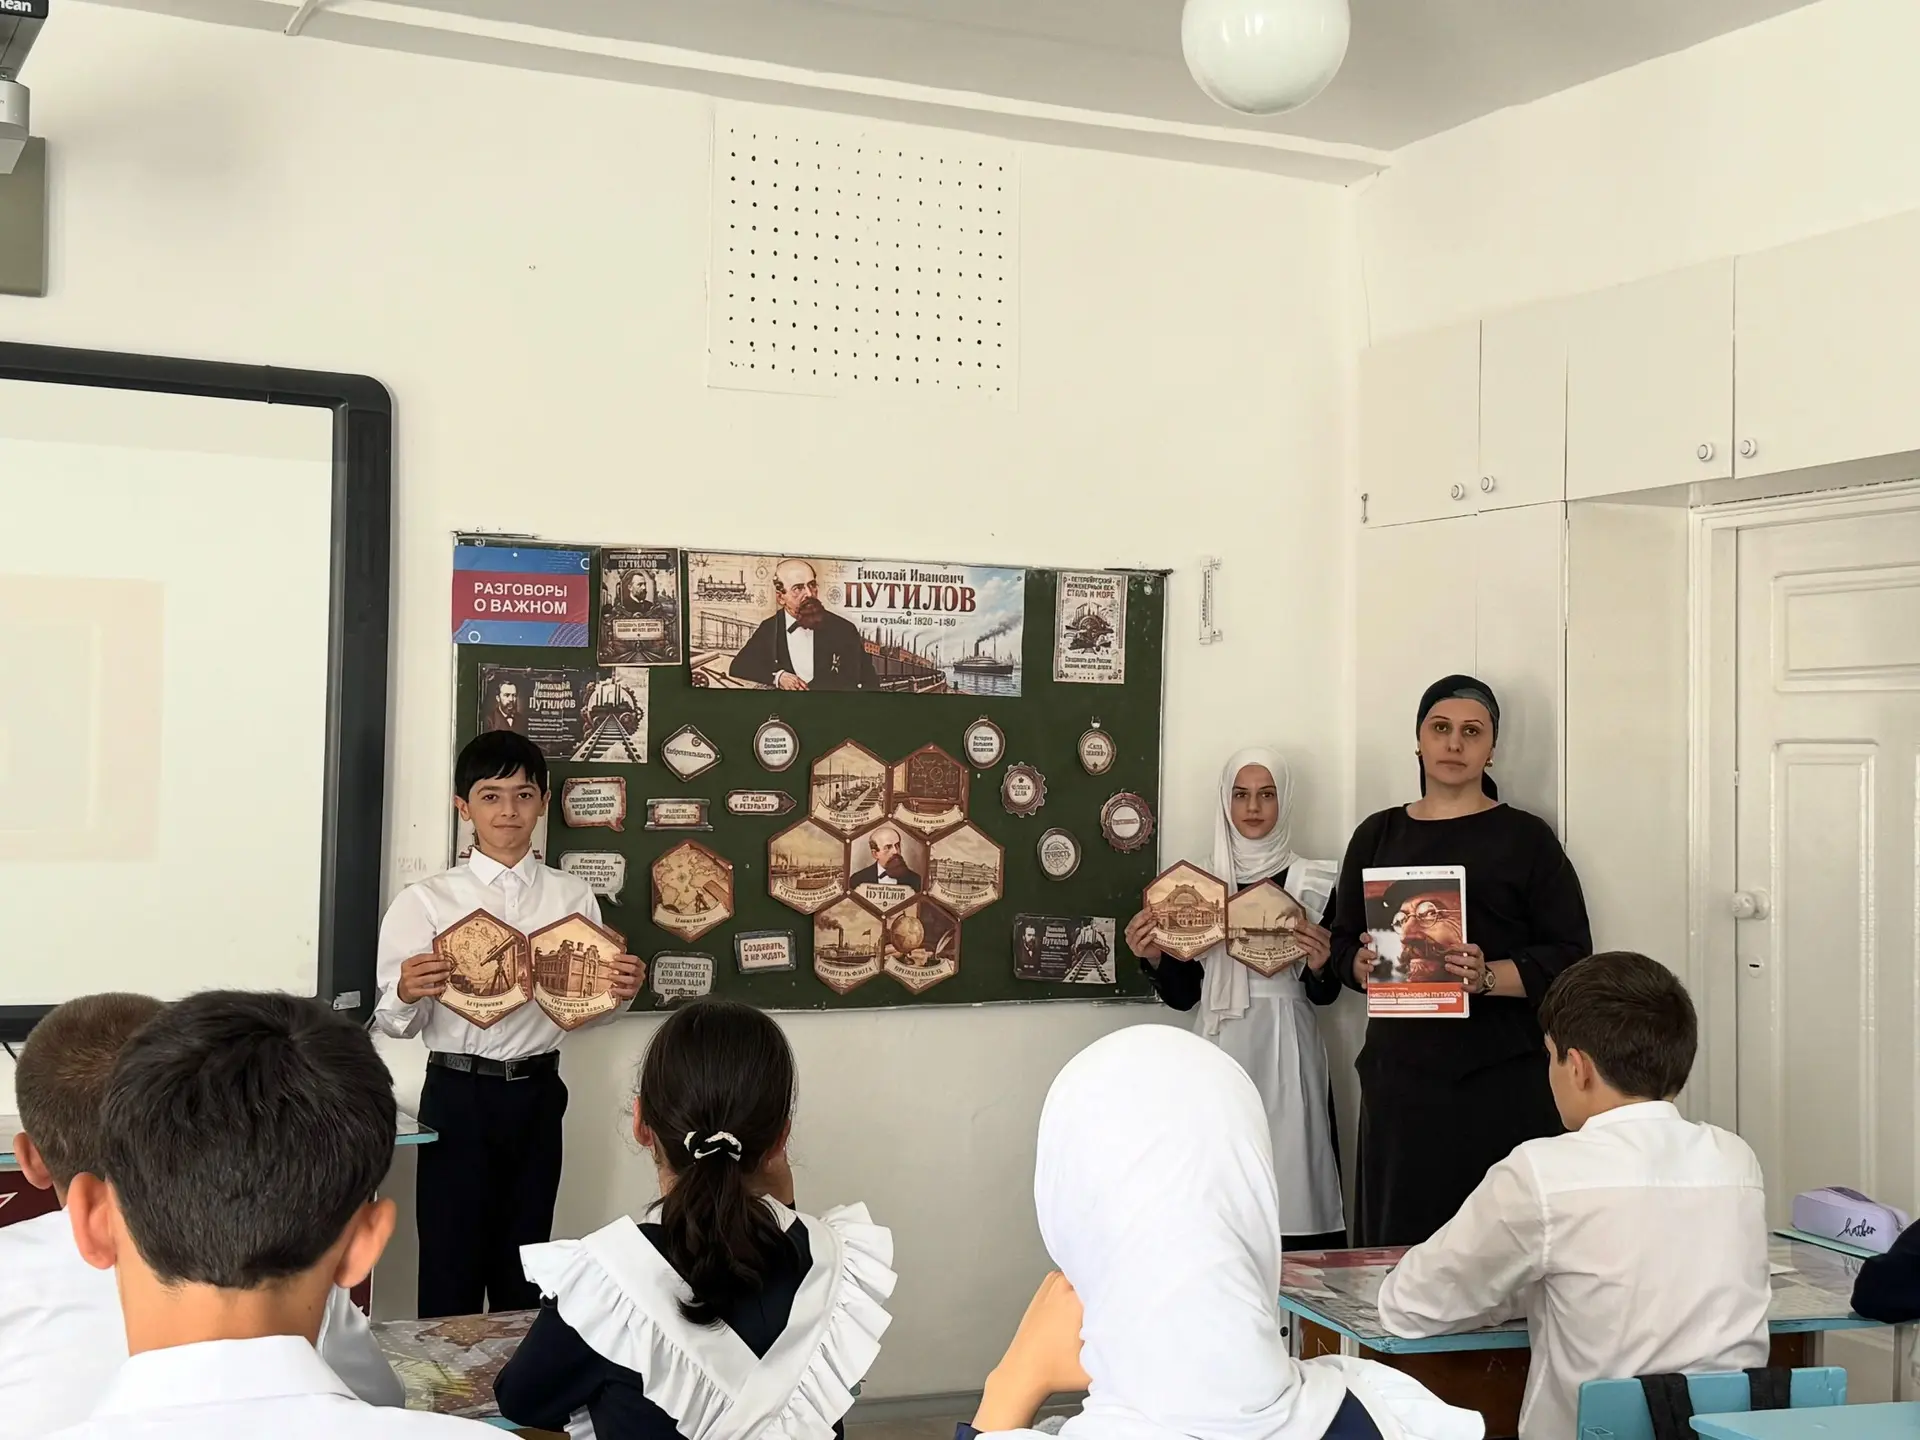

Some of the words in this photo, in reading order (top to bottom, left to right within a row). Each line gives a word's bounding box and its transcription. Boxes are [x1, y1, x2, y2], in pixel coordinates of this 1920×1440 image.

[618, 560, 657, 568] ПУТИЛОВ
[910, 569, 964, 584] Иванович
[474, 582, 568, 597] РАЗГОВОРЫ
[1067, 589, 1088, 598] СТАЛЬ
[1096, 591, 1115, 599] МОРЕ
[844, 582, 976, 612] ПУТИЛОВ
[474, 598, 487, 612] О
[490, 599, 567, 614] ВАЖНОМ
[861, 615, 878, 624] ехи
[880, 616, 911, 626] судьбы:
[865, 890, 906, 900] ПУТИЛОВ
[750, 953, 760, 961] не
